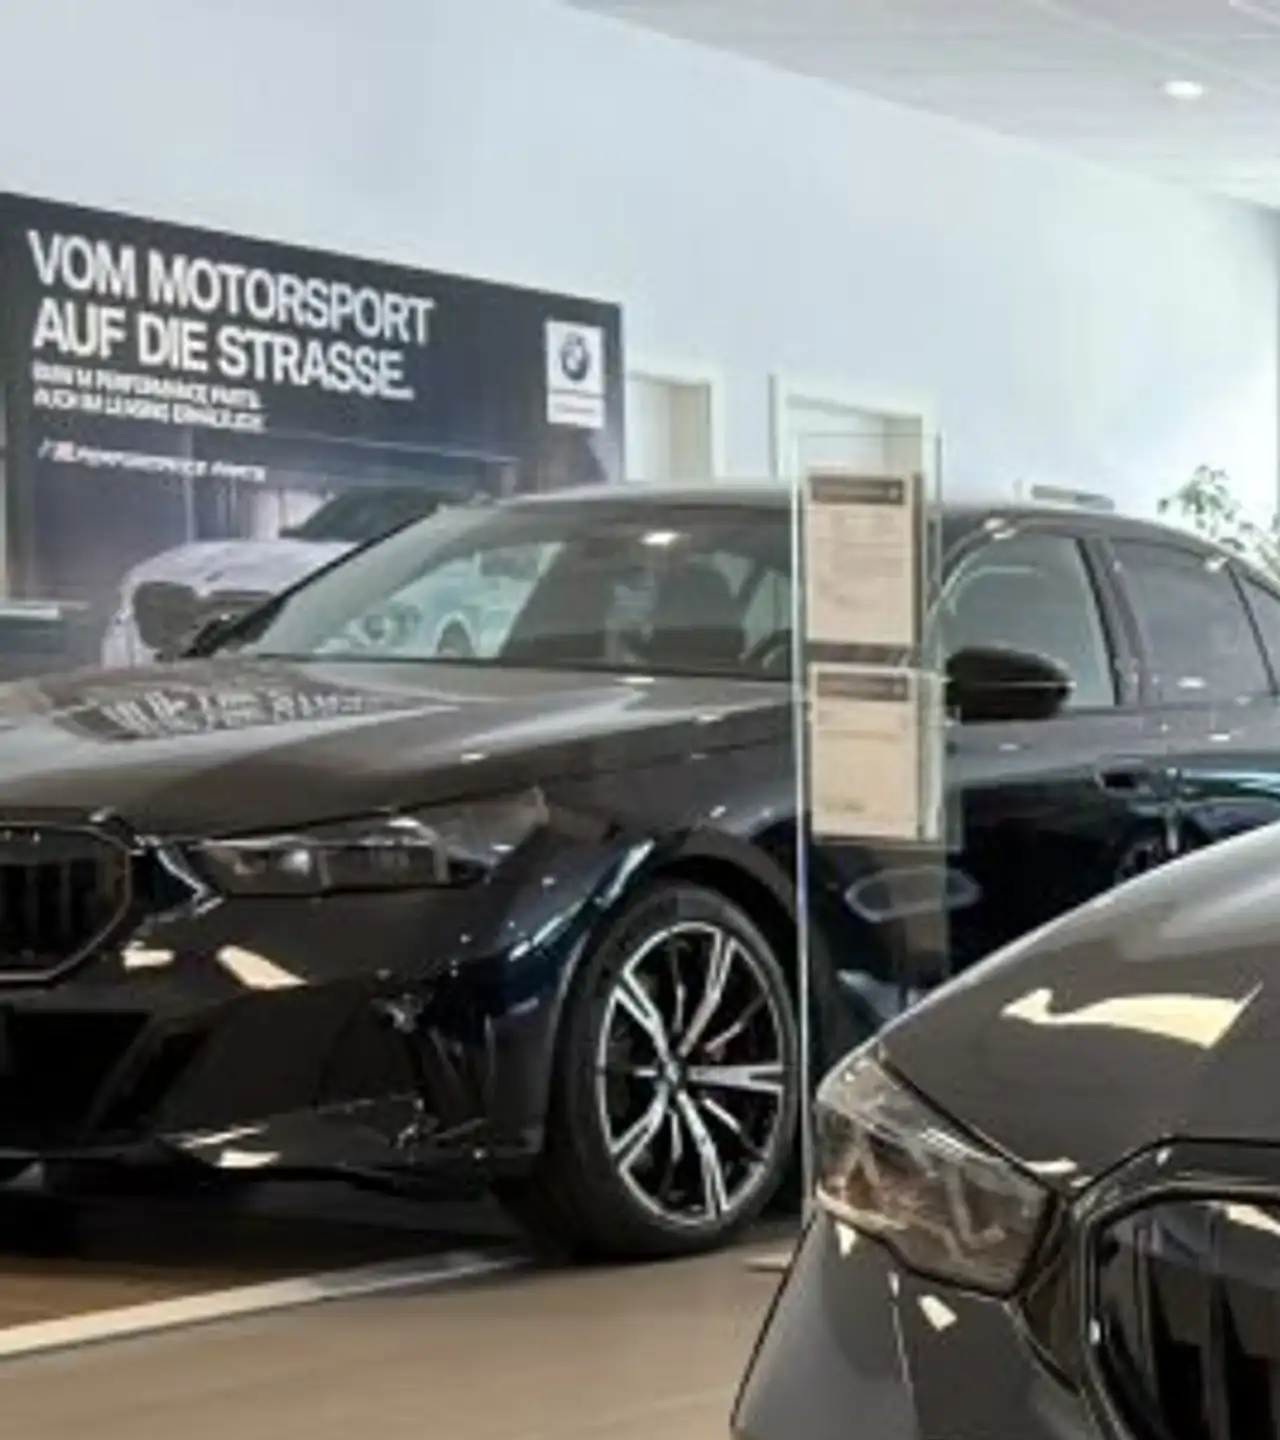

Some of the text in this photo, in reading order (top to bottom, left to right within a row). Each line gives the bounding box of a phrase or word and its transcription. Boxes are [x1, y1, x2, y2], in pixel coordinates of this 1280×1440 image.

[27, 229, 435, 346] VOM MOTORSPORT
[32, 297, 127, 359] AUF
[136, 311, 210, 372] DIE
[216, 326, 415, 400] STRASSE.
